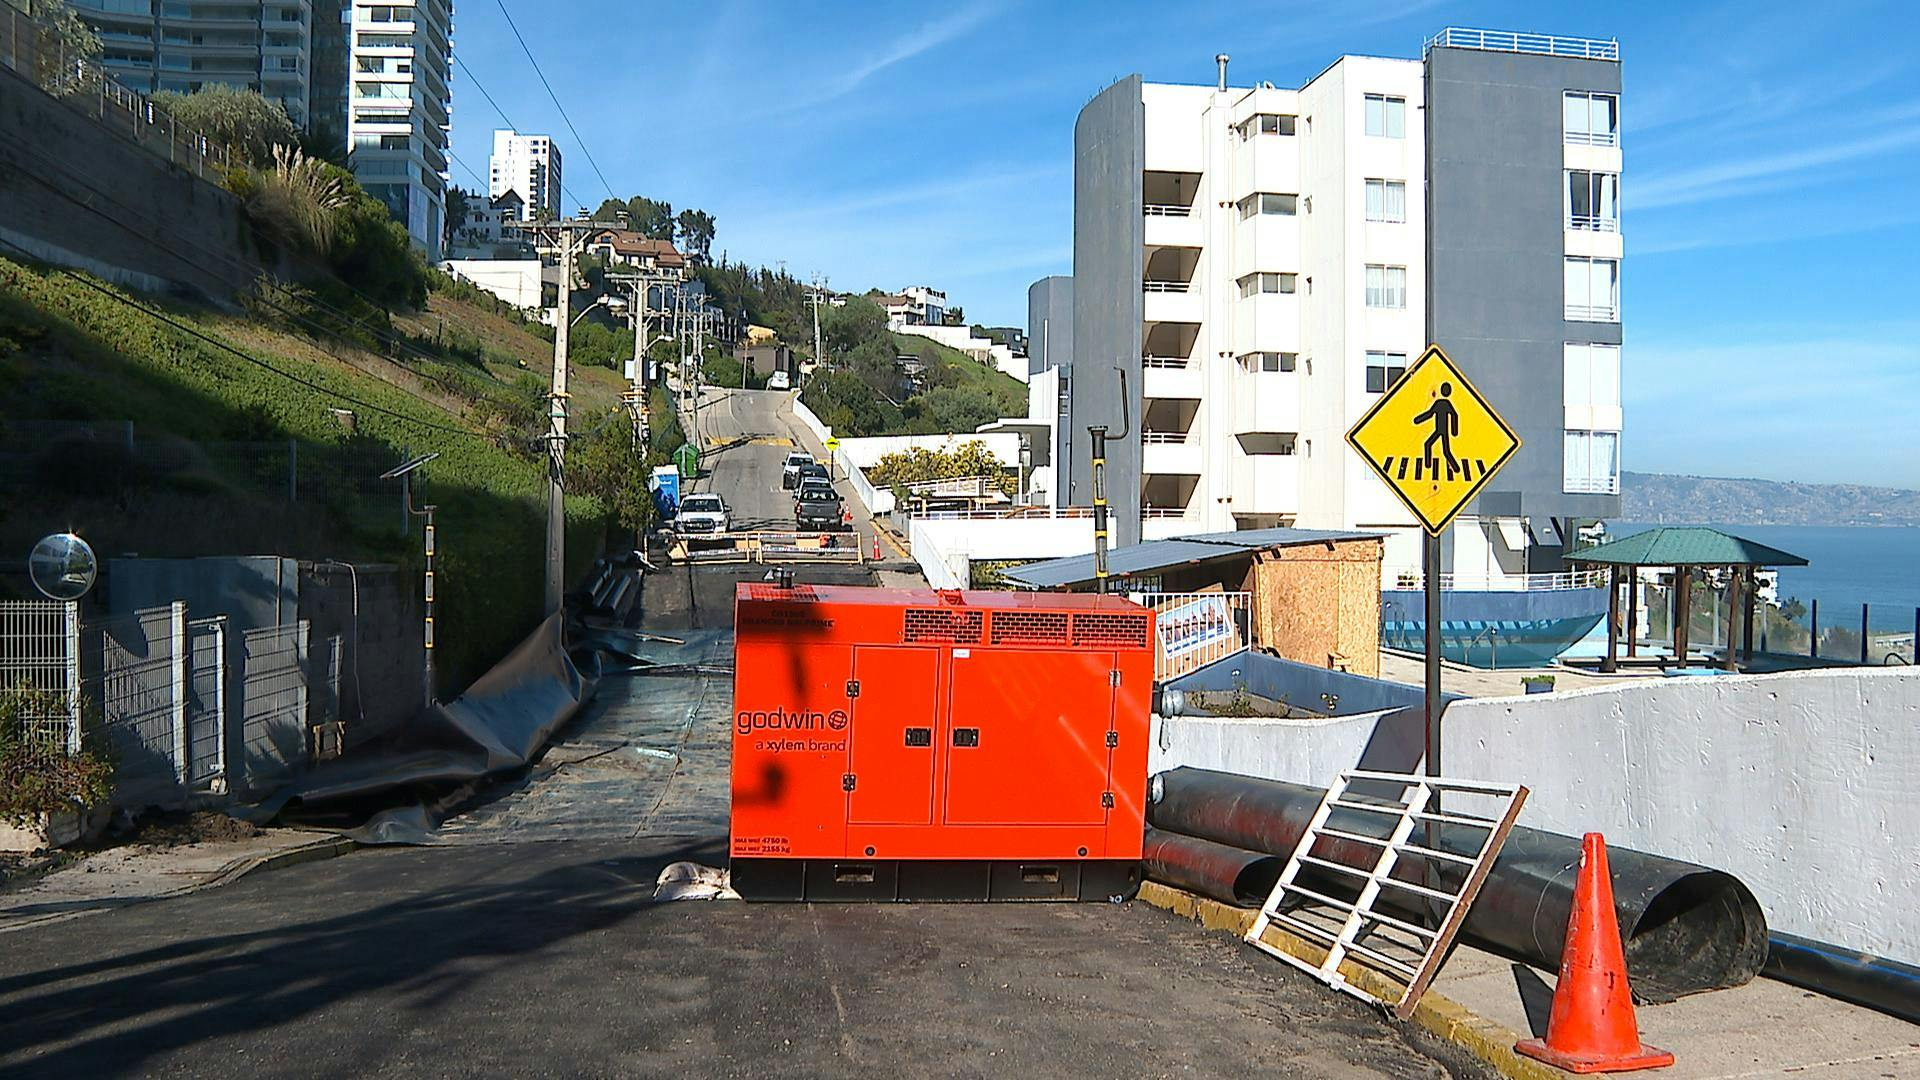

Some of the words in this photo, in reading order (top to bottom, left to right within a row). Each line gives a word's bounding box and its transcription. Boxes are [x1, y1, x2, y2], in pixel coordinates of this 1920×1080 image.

[737, 706, 825, 735] godwin
[755, 741, 764, 750] a
[766, 738, 806, 753] xylem
[808, 738, 847, 751] brand
[781, 846, 791, 854] kg
